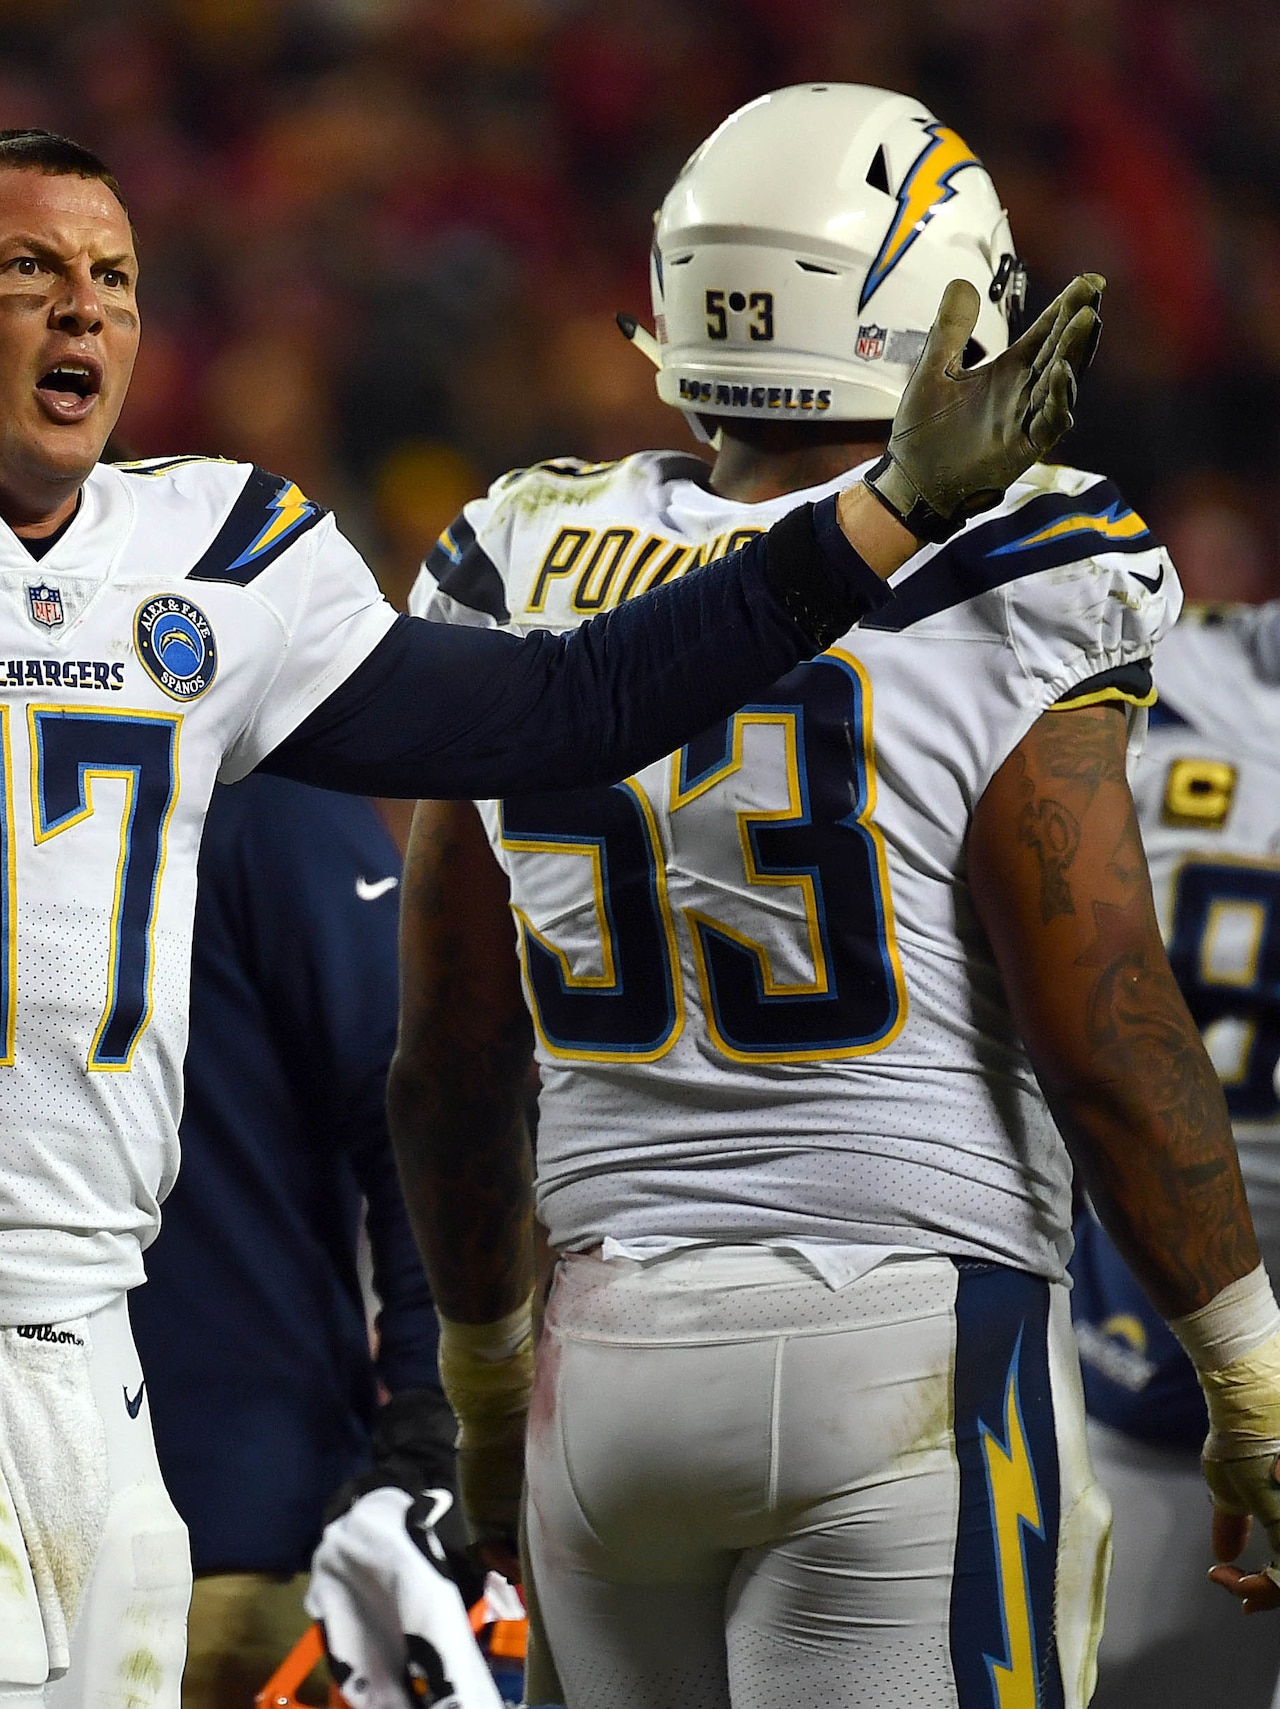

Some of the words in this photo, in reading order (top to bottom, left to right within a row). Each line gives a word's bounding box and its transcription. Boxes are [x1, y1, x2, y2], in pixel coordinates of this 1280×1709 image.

[858, 338, 881, 357] NFL
[678, 378, 713, 402] LOS
[715, 385, 832, 410] ANGELES
[34, 601, 61, 623] NFL
[140, 600, 168, 632] ALEX
[167, 598, 180, 611] &
[181, 602, 211, 638] FAYE
[160, 671, 205, 694] SPANOS
[500, 647, 908, 1063] 53
